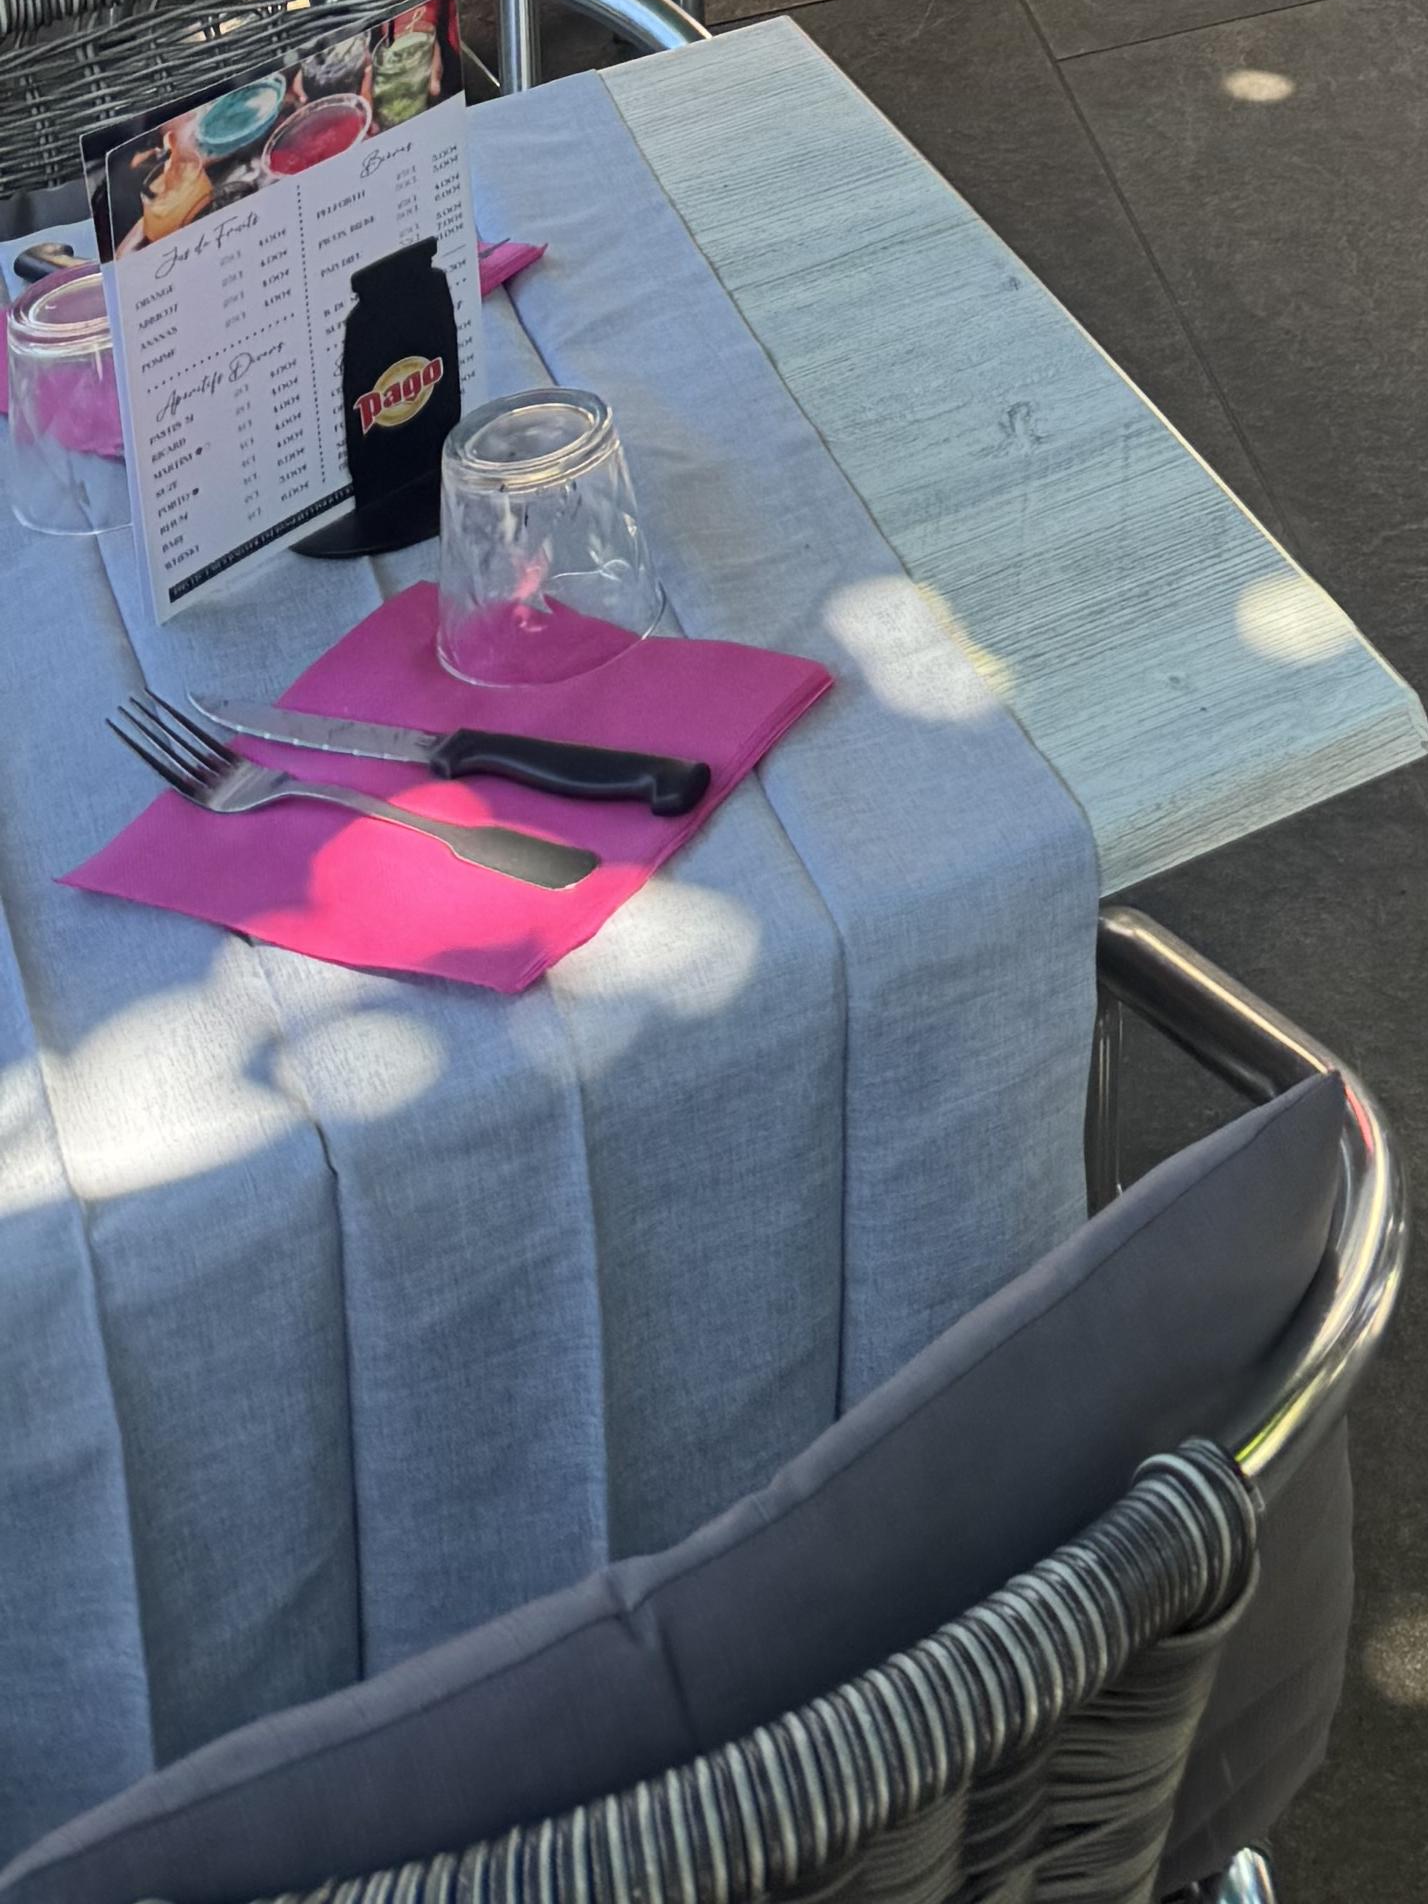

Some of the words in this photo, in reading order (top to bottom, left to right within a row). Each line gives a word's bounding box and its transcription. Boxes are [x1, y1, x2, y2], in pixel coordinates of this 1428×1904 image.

[135, 283, 174, 310] ORANGE
[140, 325, 179, 351] ANANAS
[141, 348, 176, 373] POMME
[353, 356, 444, 436] pago
[152, 438, 187, 463] RICARD
